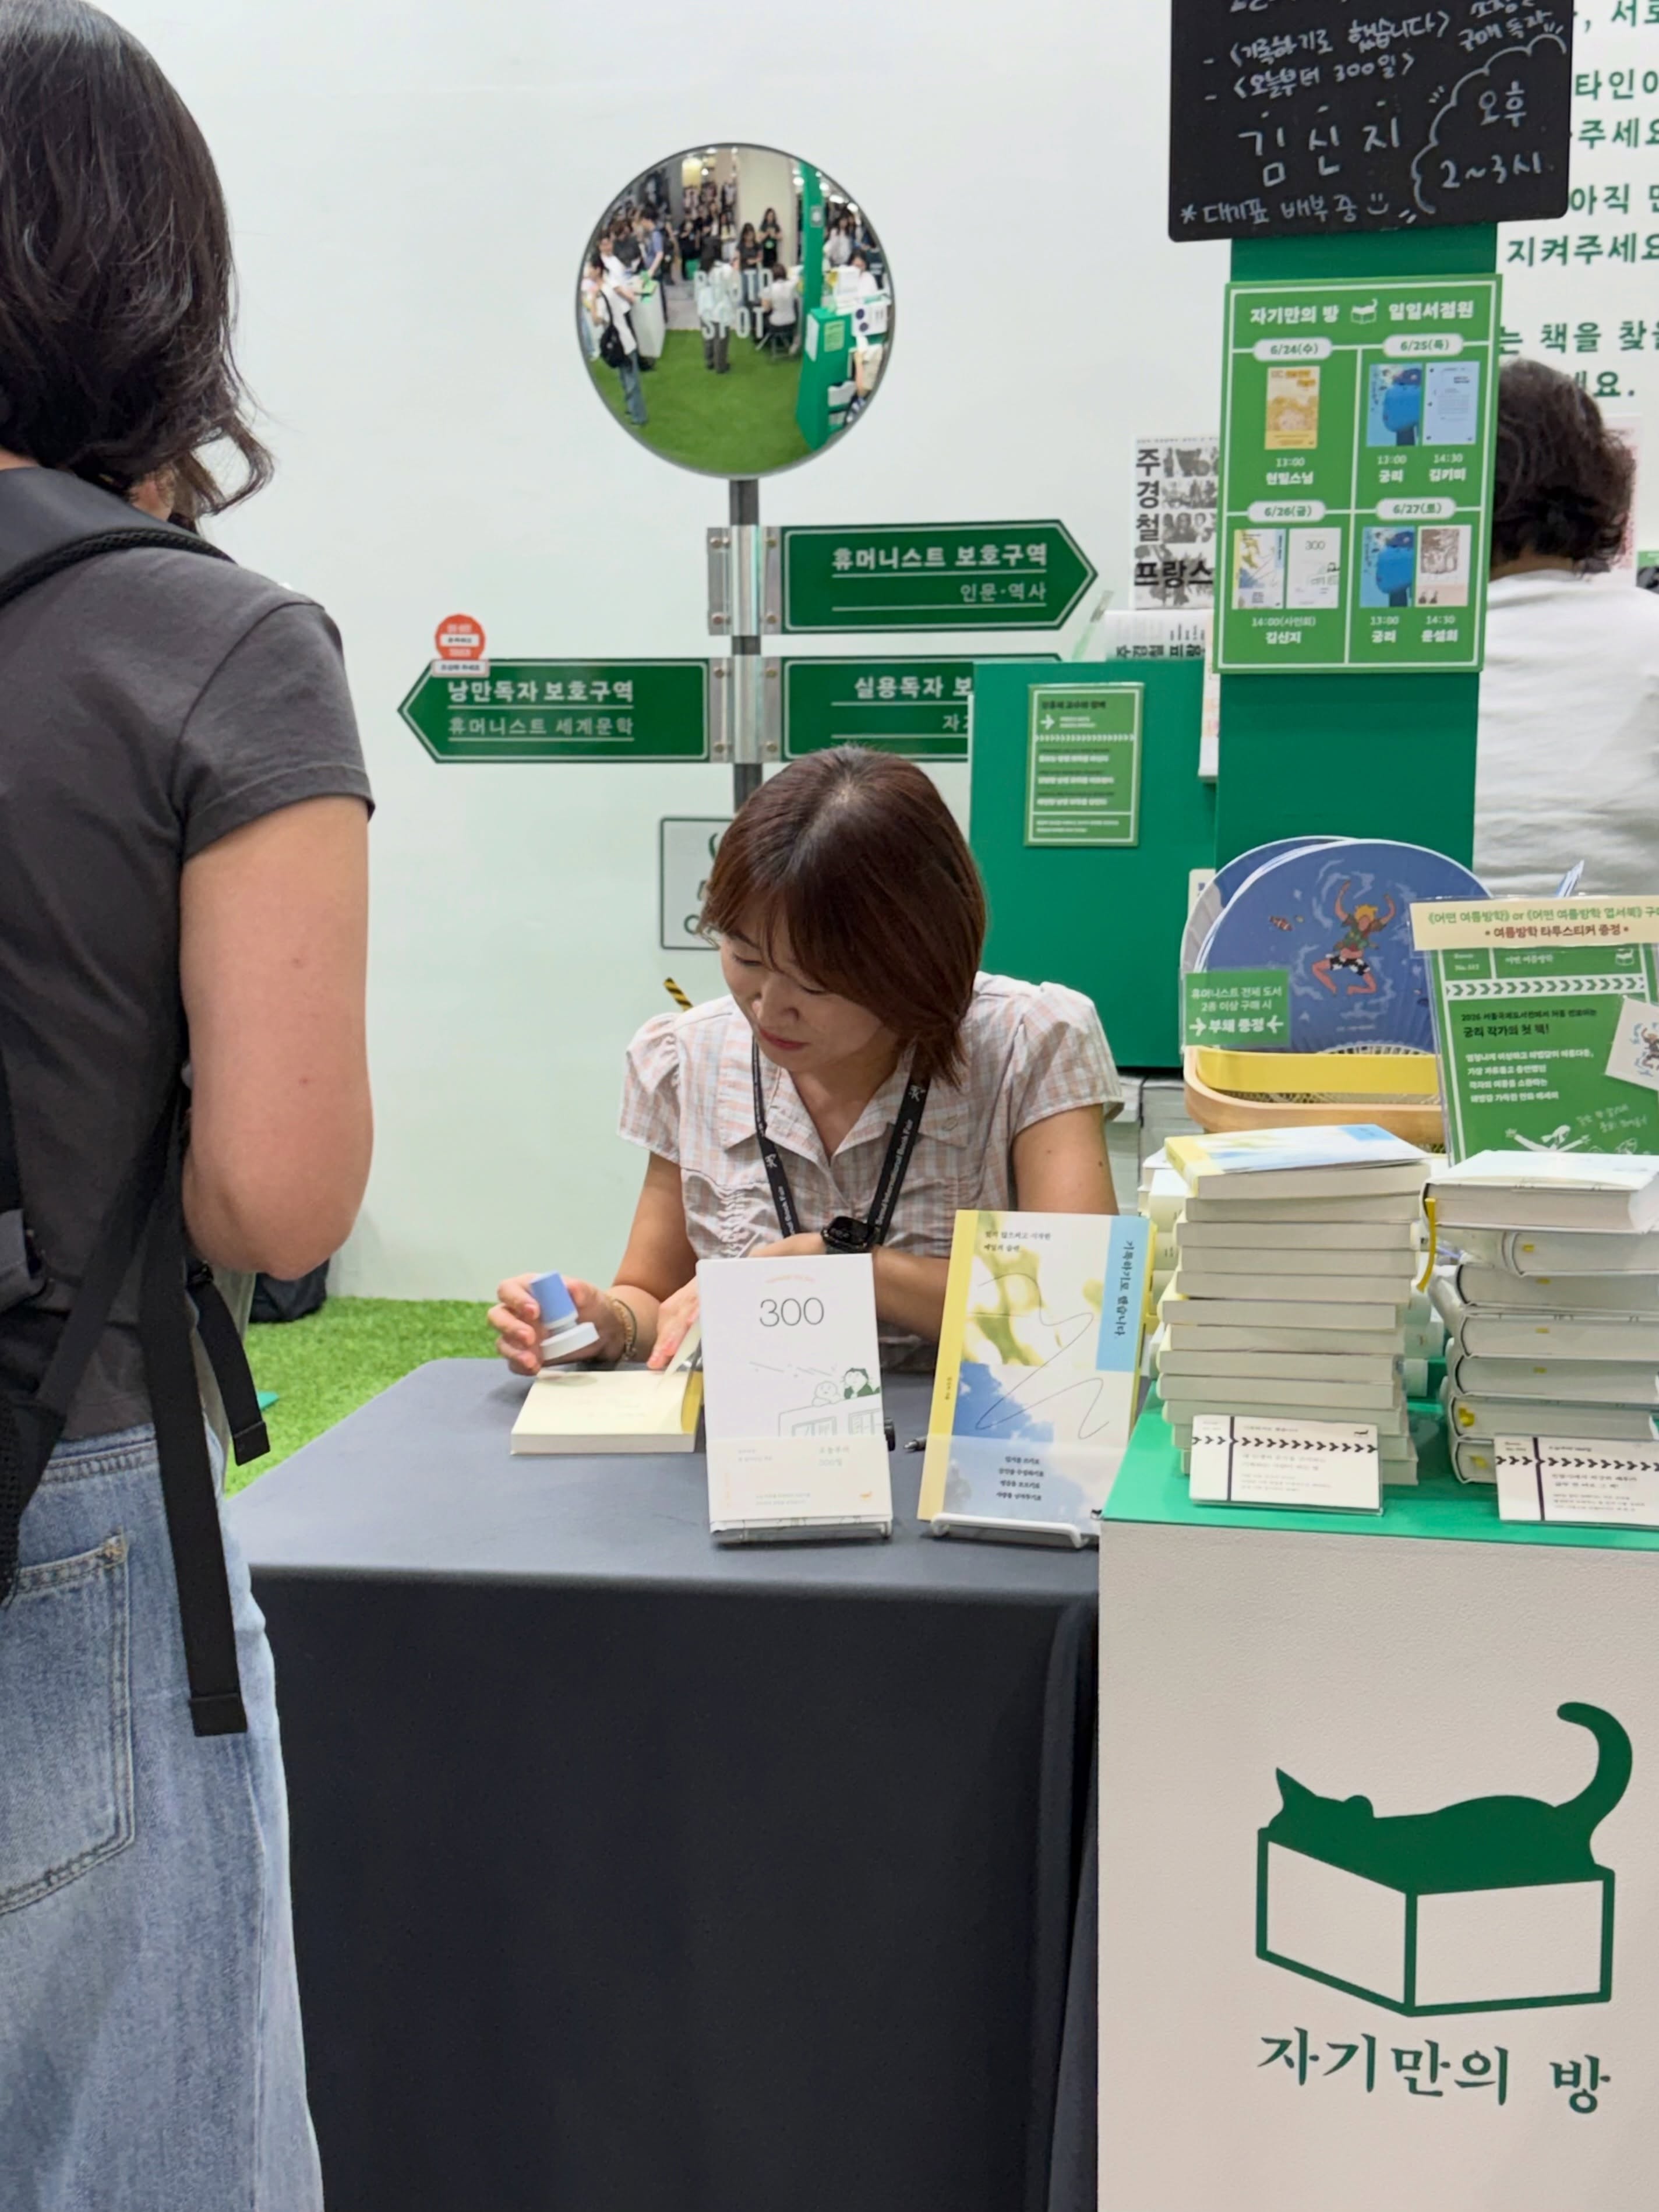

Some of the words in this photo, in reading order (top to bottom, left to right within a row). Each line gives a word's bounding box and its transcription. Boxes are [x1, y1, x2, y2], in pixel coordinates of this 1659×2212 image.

[1480, 81, 1526, 127] 오후
[1570, 184, 1629, 215] 아직
[1250, 306, 1316, 324] 자기만의
[1322, 305, 1339, 323] 방
[1541, 322, 1601, 353] 책을
[1136, 449, 1161, 542] 주경철
[832, 548, 946, 570] 휴머니스트
[956, 544, 1047, 566] 보호구역
[1134, 560, 1213, 588] 프랑스
[448, 680, 537, 703] 낭만독자
[544, 680, 634, 701] 보호구역
[855, 676, 943, 699] 실용독자
[448, 718, 547, 736] 휴머니스트
[556, 718, 633, 736] 세계문학
[1120, 1241, 1134, 1291] 기록하기로
[760, 1297, 825, 1327] 300
[1258, 2026, 1509, 2107] 자기만의
[1549, 2054, 1612, 2115] 방
